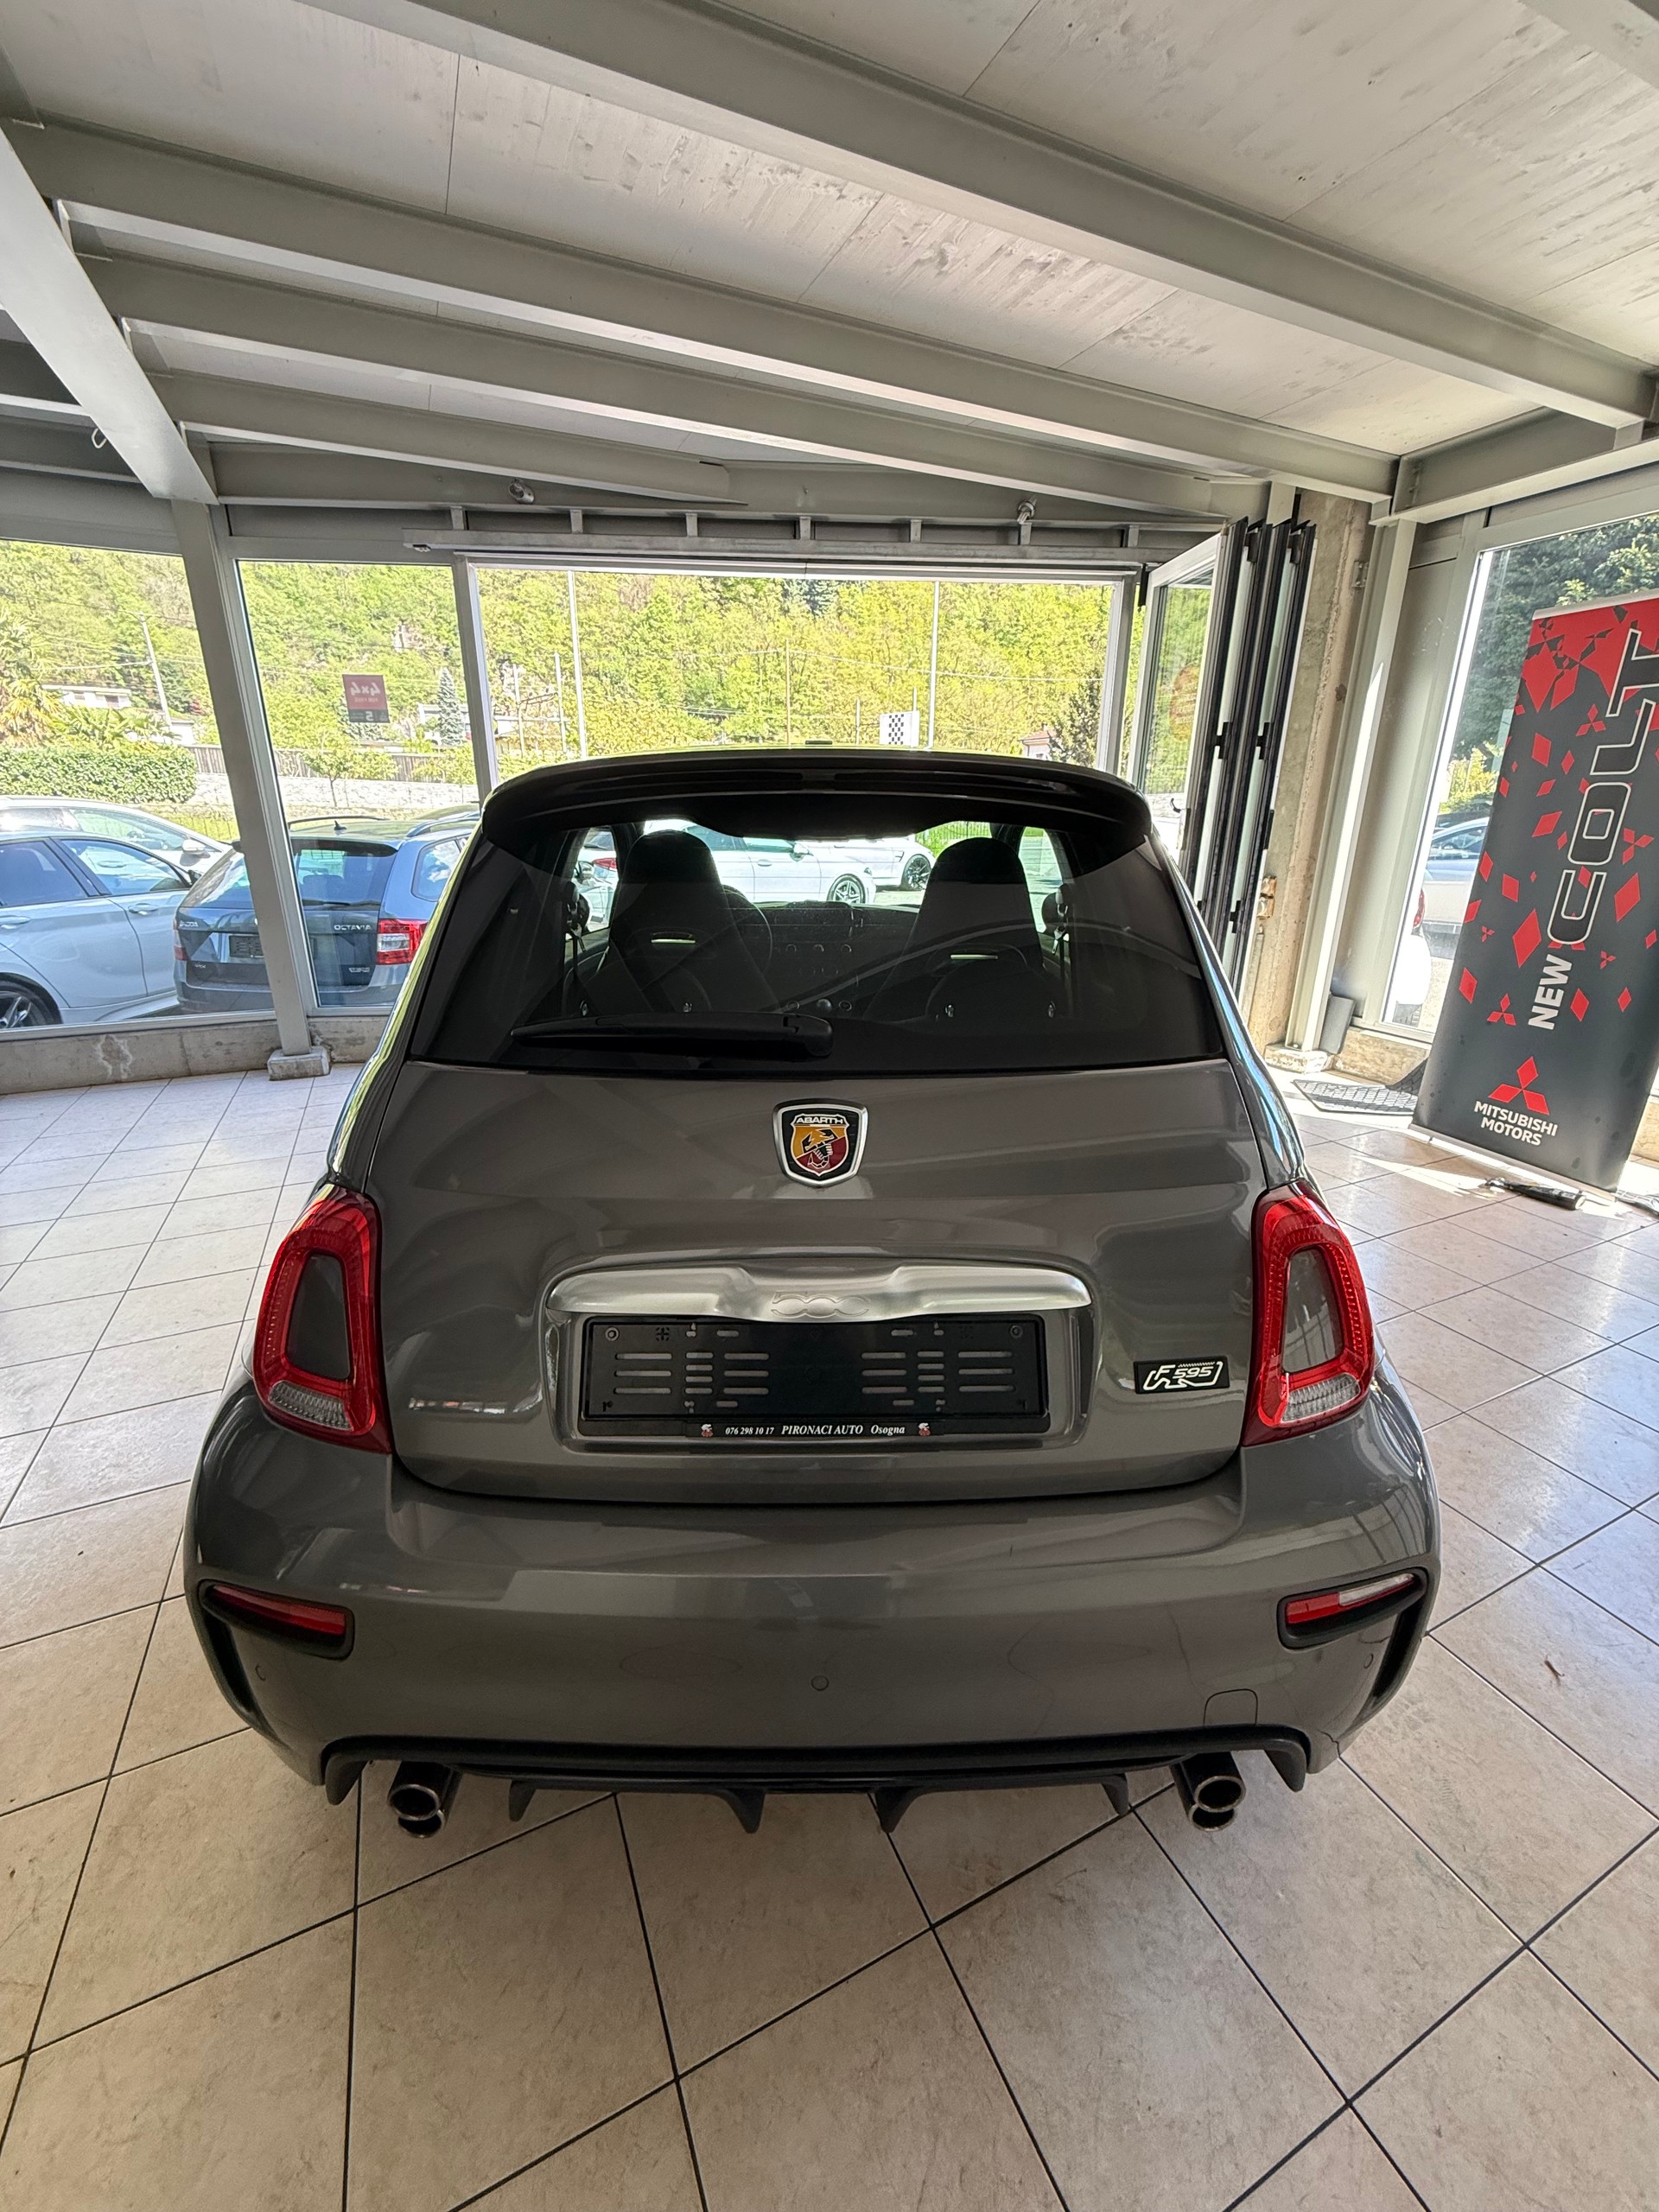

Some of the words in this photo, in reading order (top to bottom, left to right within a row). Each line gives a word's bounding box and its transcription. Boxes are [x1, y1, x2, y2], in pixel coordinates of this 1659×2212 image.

[1548, 628, 1659, 944] COLT
[1528, 954, 1572, 1030] NEW
[1474, 1101, 1558, 1136] MITSUBISHI
[1480, 1116, 1542, 1146] MOTORS
[725, 1427, 739, 1435] 076
[740, 1427, 753, 1435] 298
[754, 1427, 764, 1435] 10
[766, 1427, 775, 1435] 17
[781, 1425, 833, 1435] PIRONACI
[833, 1425, 864, 1435] AUTO
[870, 1424, 906, 1436] Osogna
